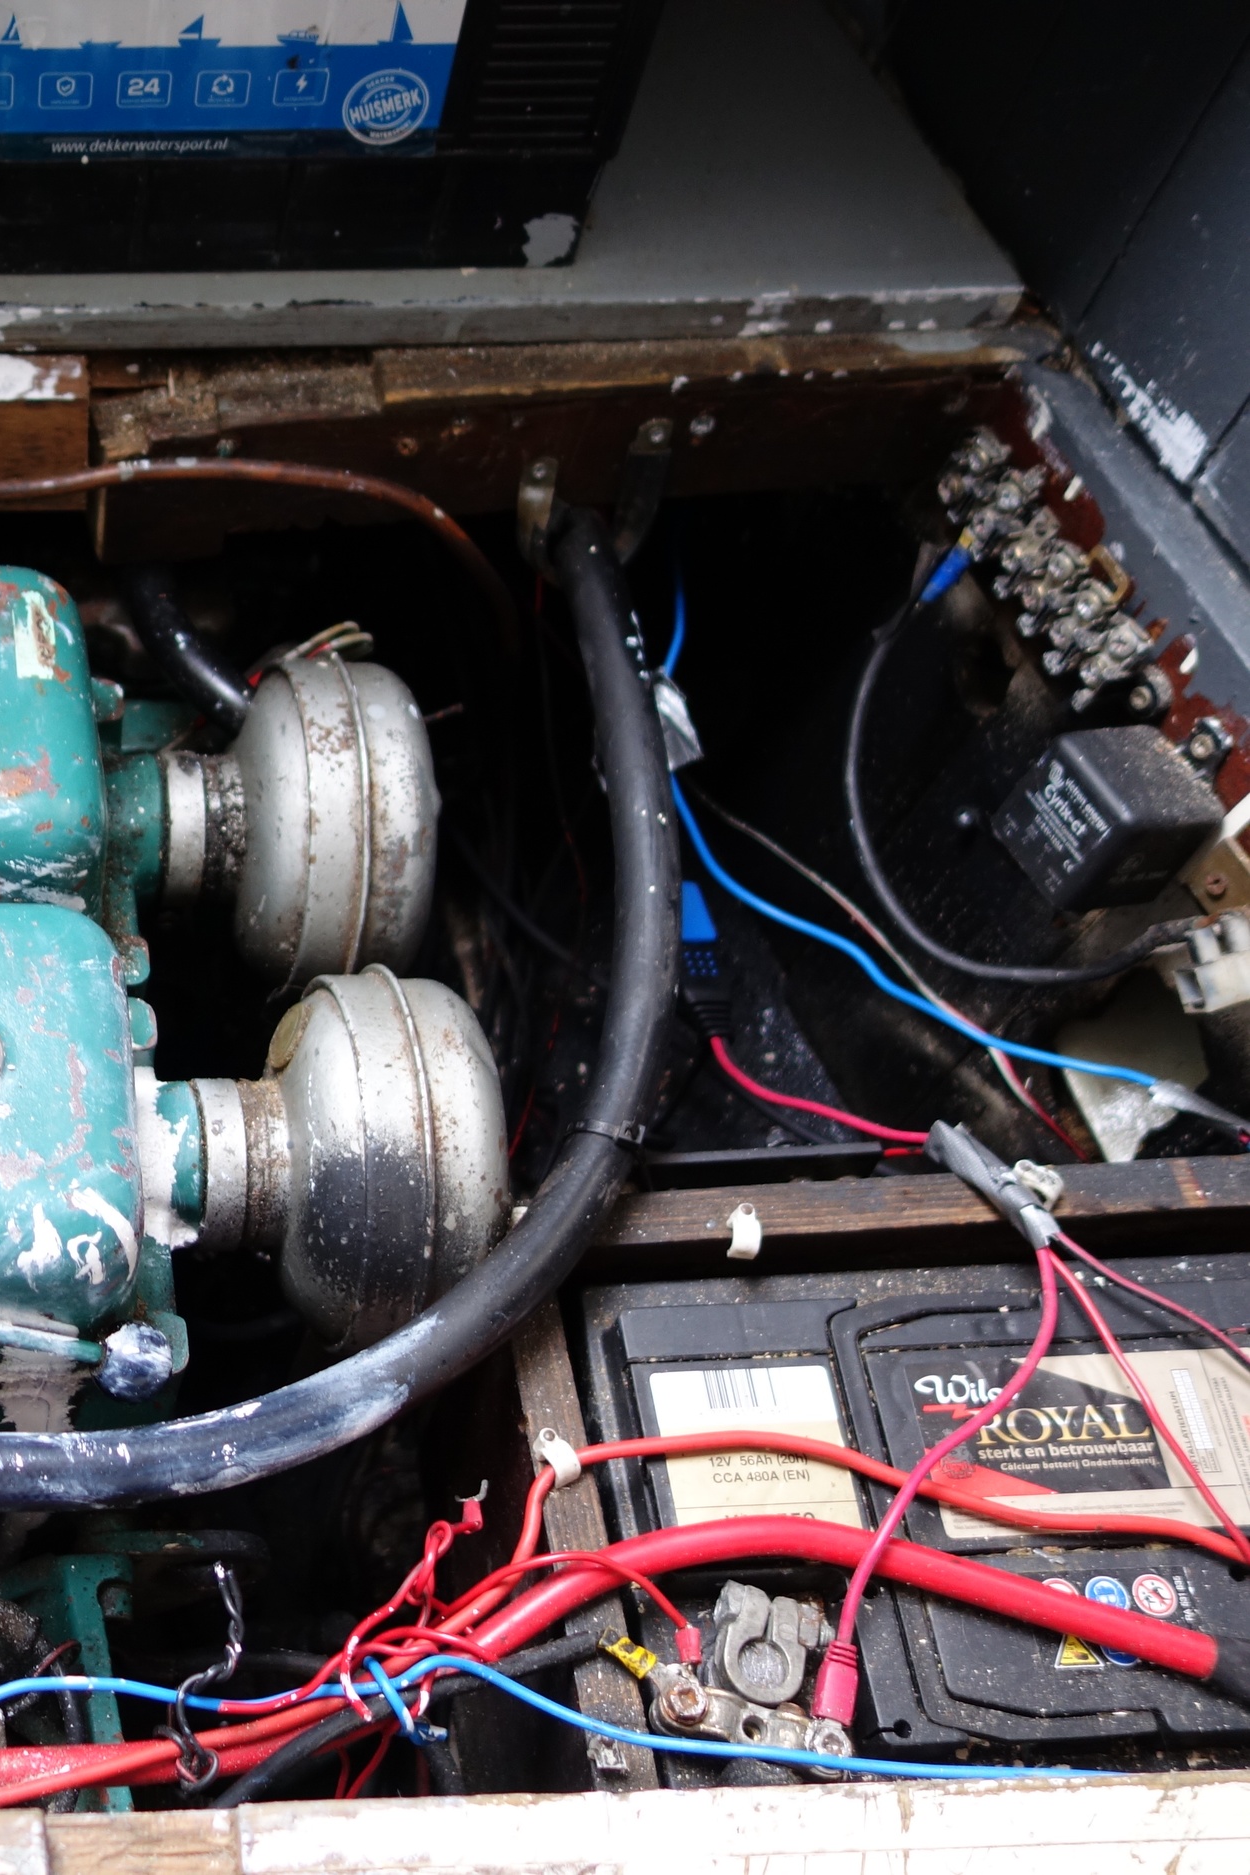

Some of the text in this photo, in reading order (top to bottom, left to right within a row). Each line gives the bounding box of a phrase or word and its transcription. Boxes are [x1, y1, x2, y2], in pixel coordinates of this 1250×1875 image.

[128, 78, 161, 96] 24
[350, 87, 422, 125] HUISMERK
[52, 138, 229, 154] www.dekkerwatersport.nl
[967, 1403, 1151, 1446] ROYAL
[978, 1440, 1155, 1460] sterk en betrouwbaar
[708, 1453, 808, 1467] 12V 56Ah (20h)
[1043, 1460, 1079, 1470] batterij
[713, 1470, 811, 1483] CCA 480A (EN)
